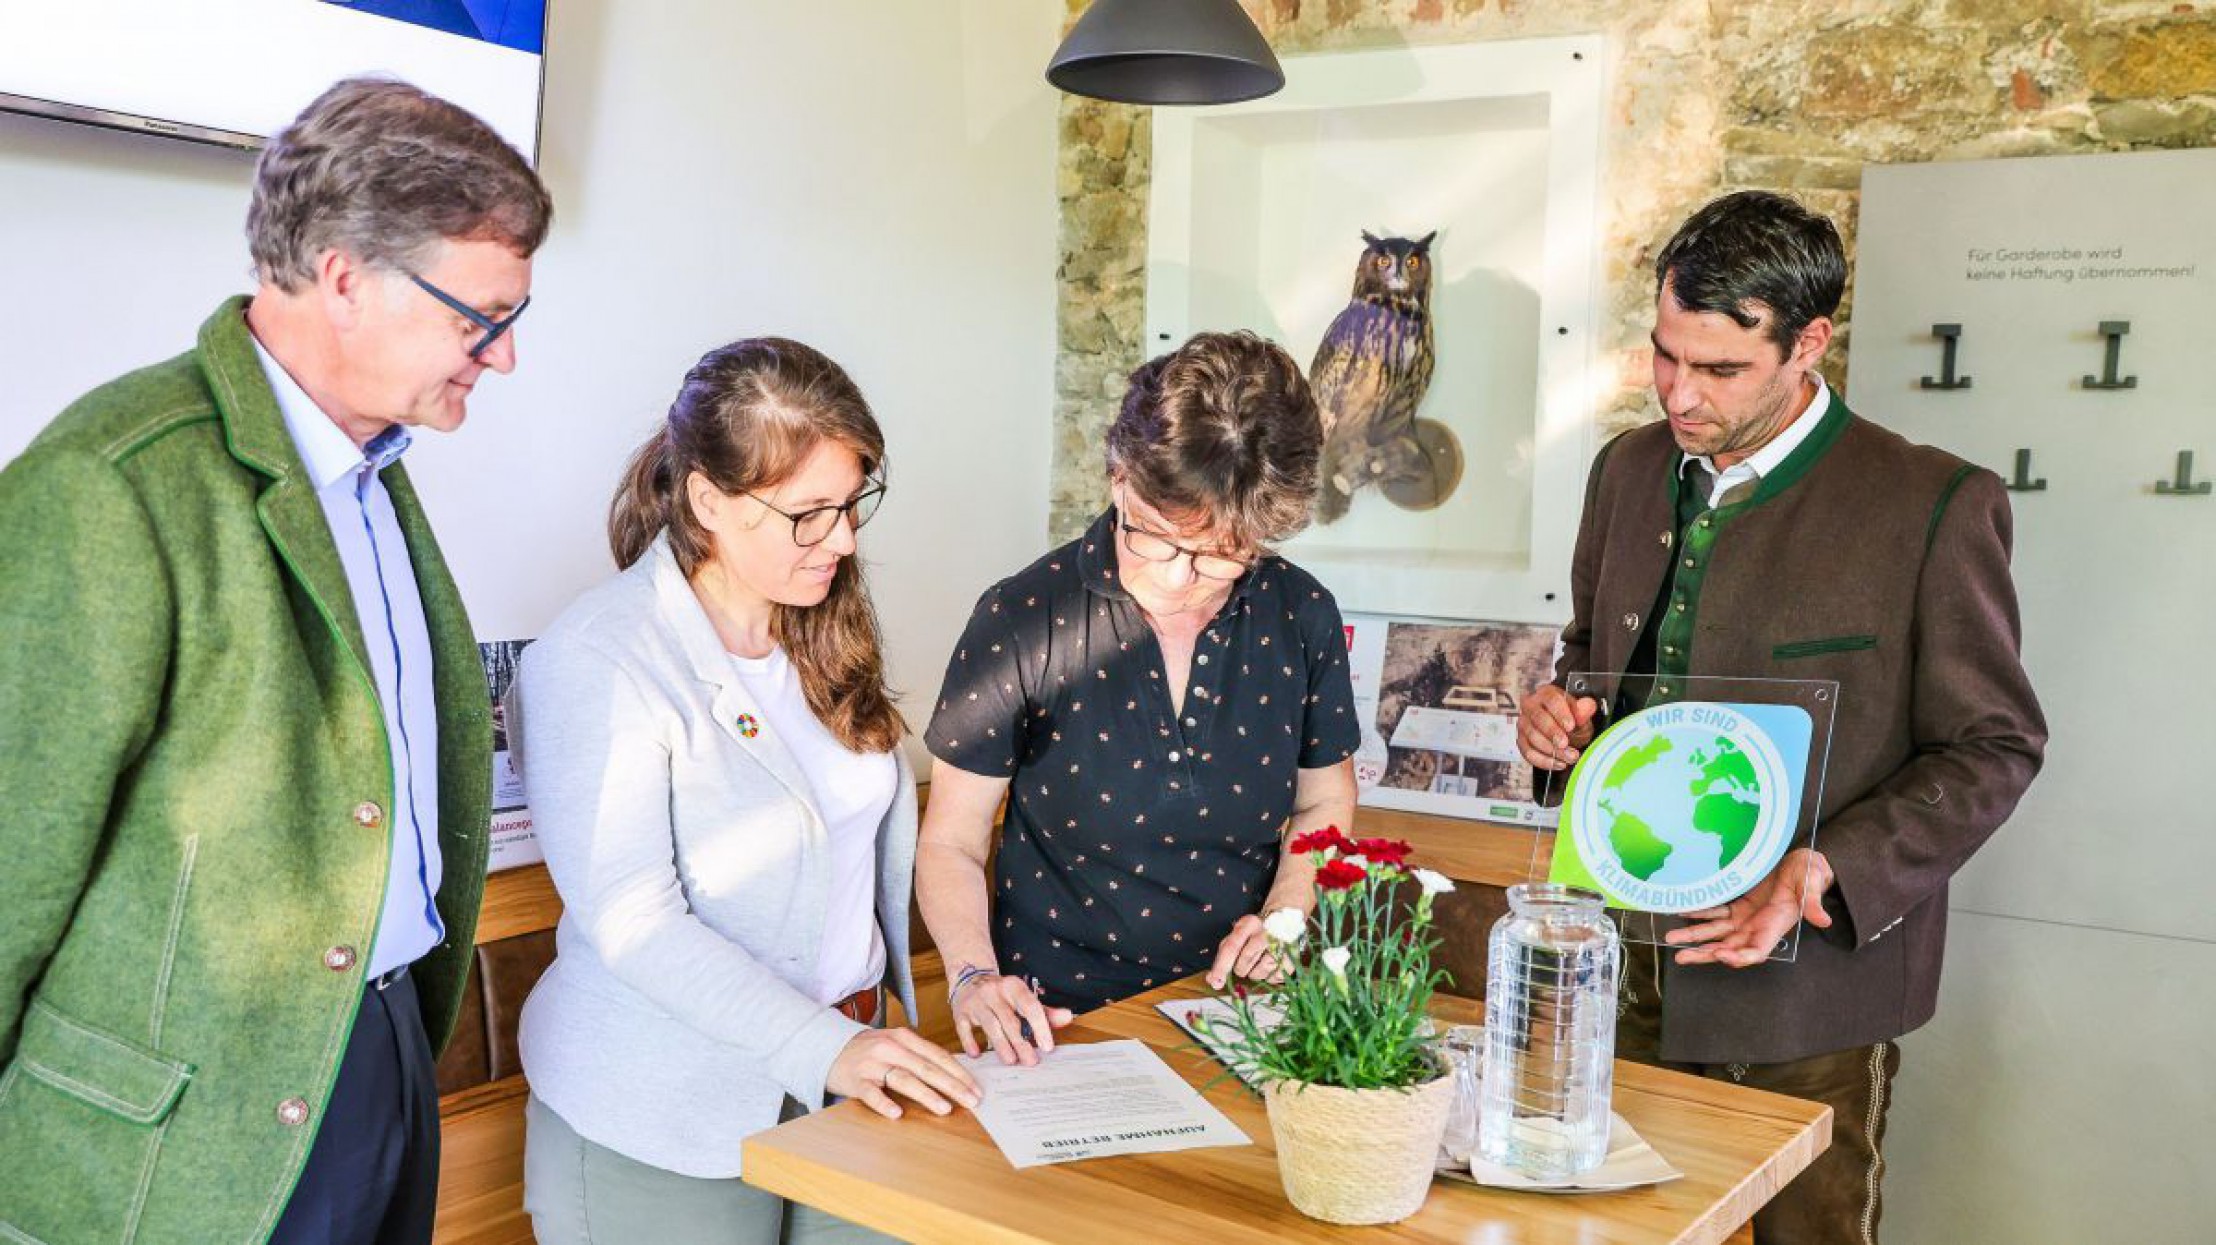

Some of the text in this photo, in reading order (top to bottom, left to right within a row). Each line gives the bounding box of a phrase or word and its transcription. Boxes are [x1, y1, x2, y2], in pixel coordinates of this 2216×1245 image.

[1968, 246, 2122, 262] Für Garderobe wird
[1966, 264, 2195, 284] keine Haftung übernommen!
[1646, 708, 1739, 732] WIR SIND
[1596, 859, 1742, 907] KLIMABÜNDNIS
[1041, 1135, 1113, 1149] BETRIEB
